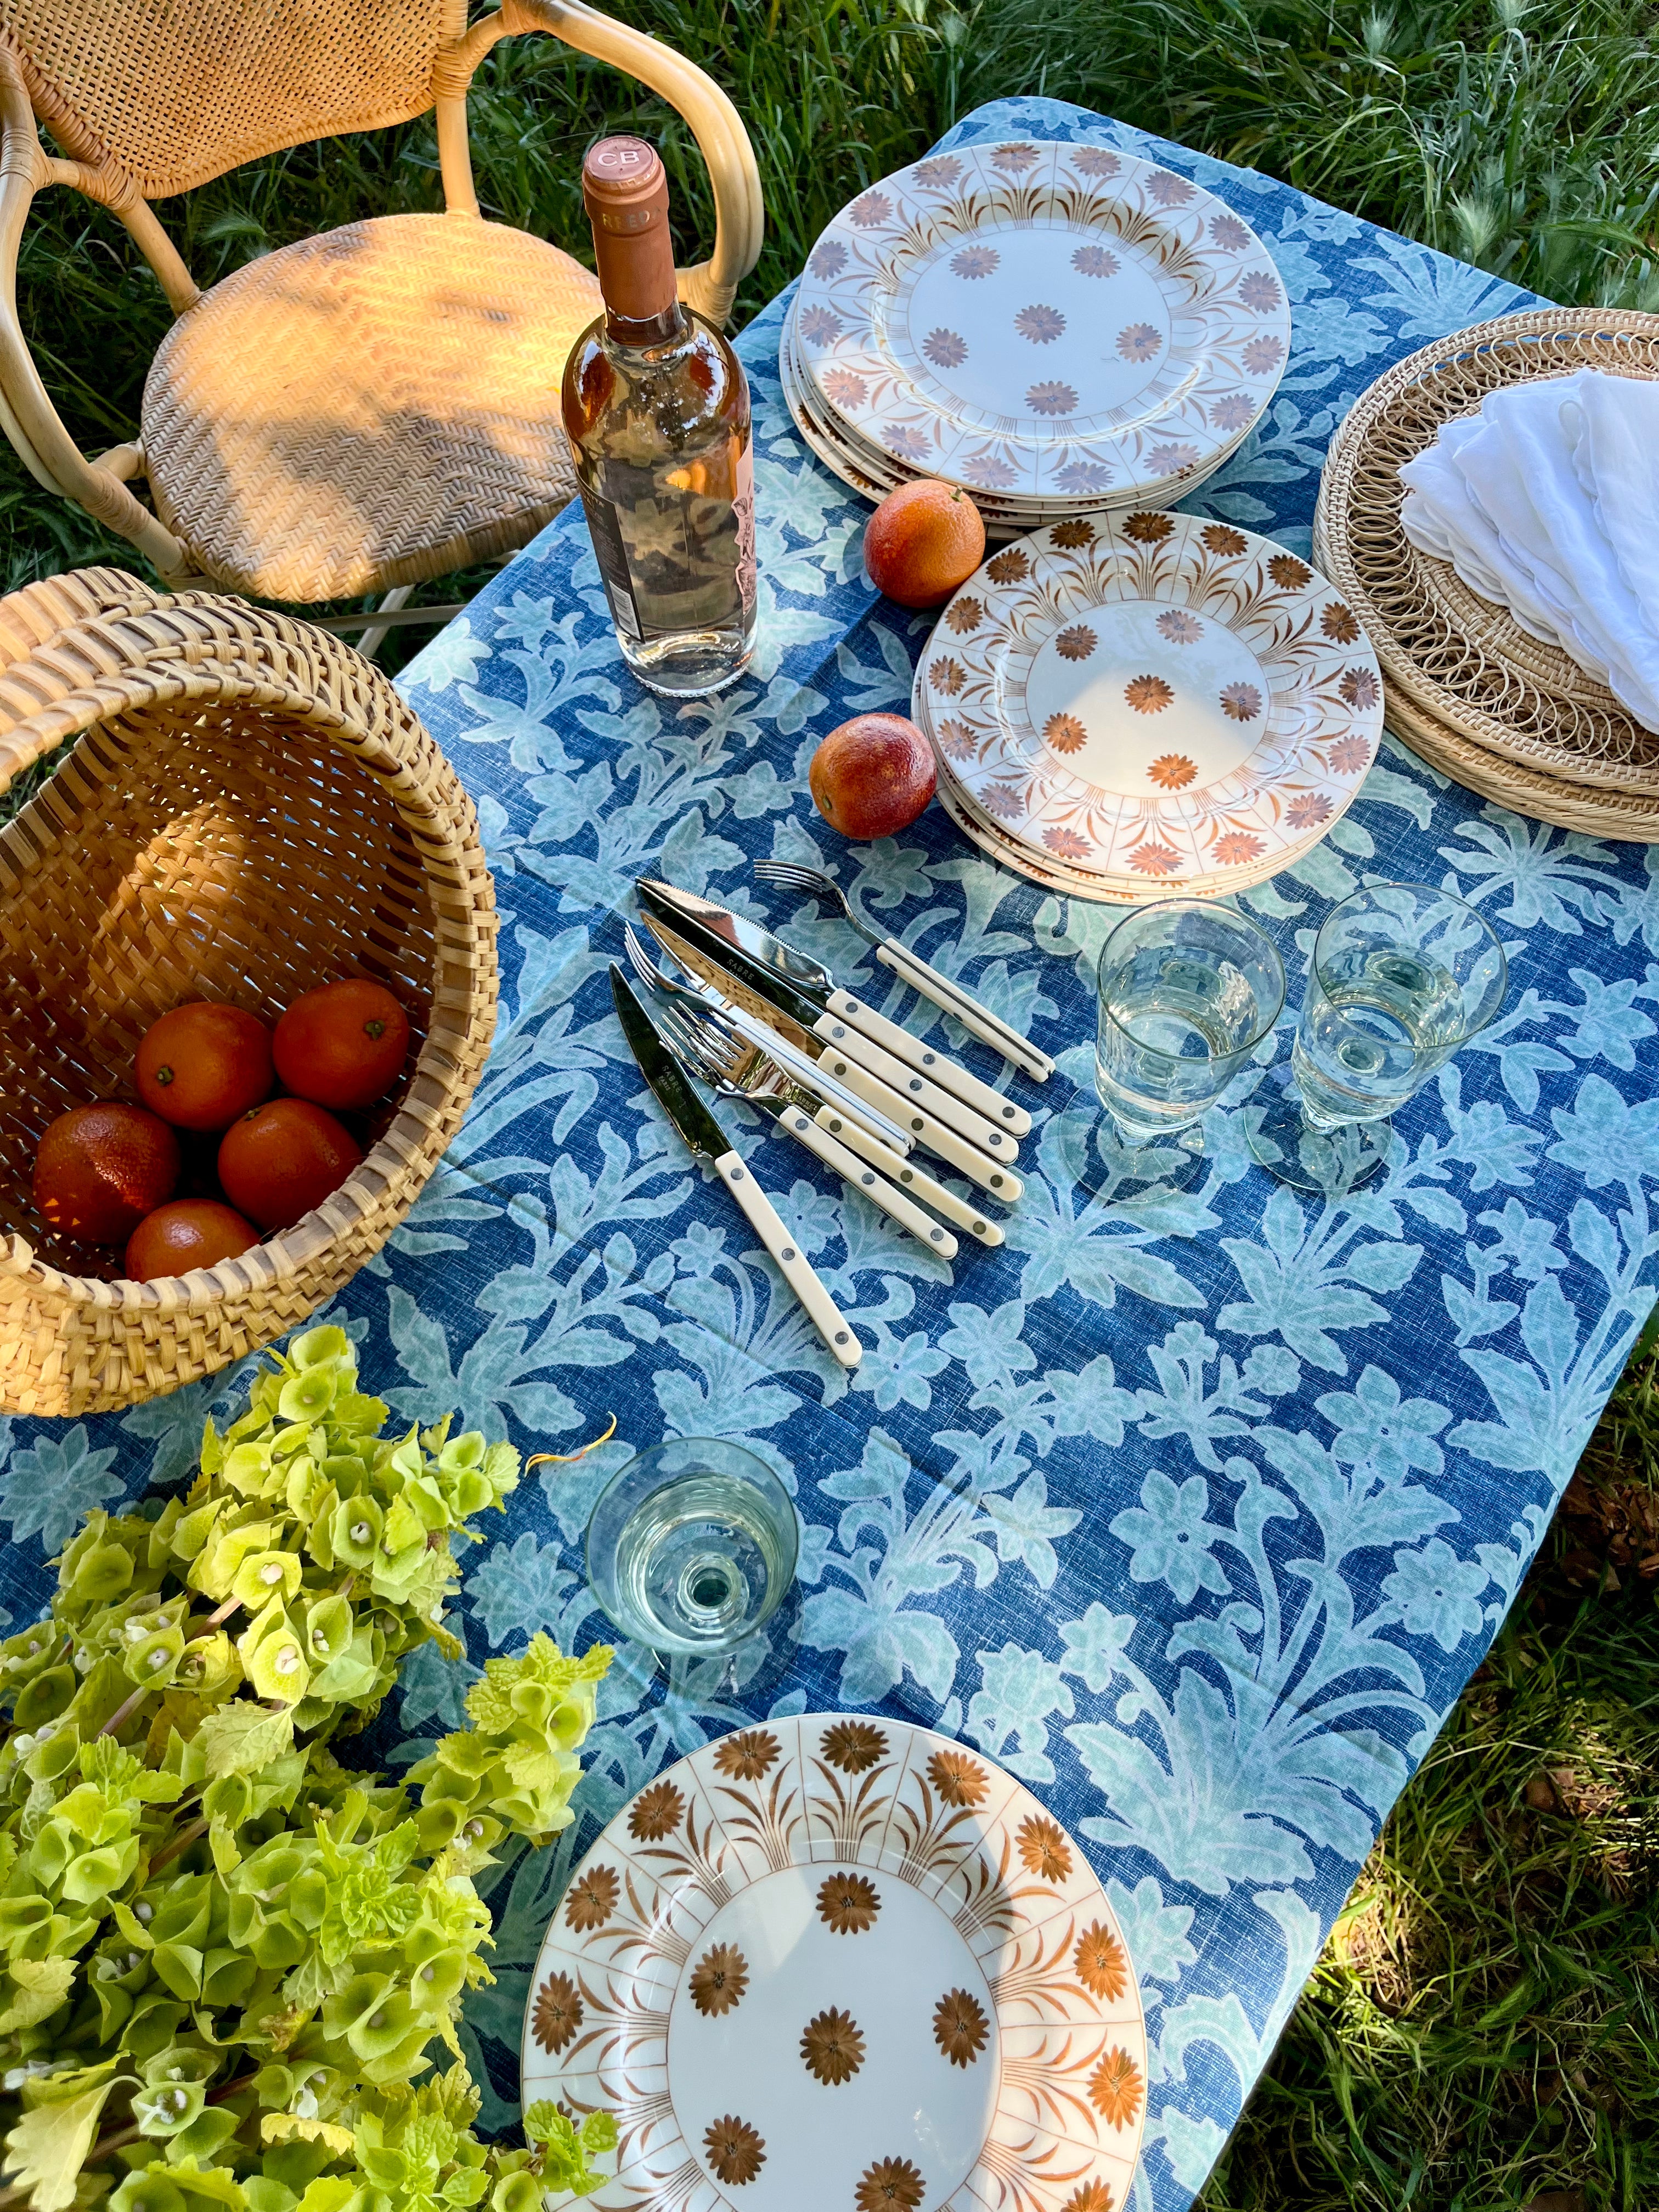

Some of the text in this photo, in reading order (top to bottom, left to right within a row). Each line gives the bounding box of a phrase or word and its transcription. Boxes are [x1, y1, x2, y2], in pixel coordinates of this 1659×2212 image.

[598, 151, 640, 167] CB
[727, 959, 754, 980] SABRE
[662, 1065, 682, 1093] SABRE
